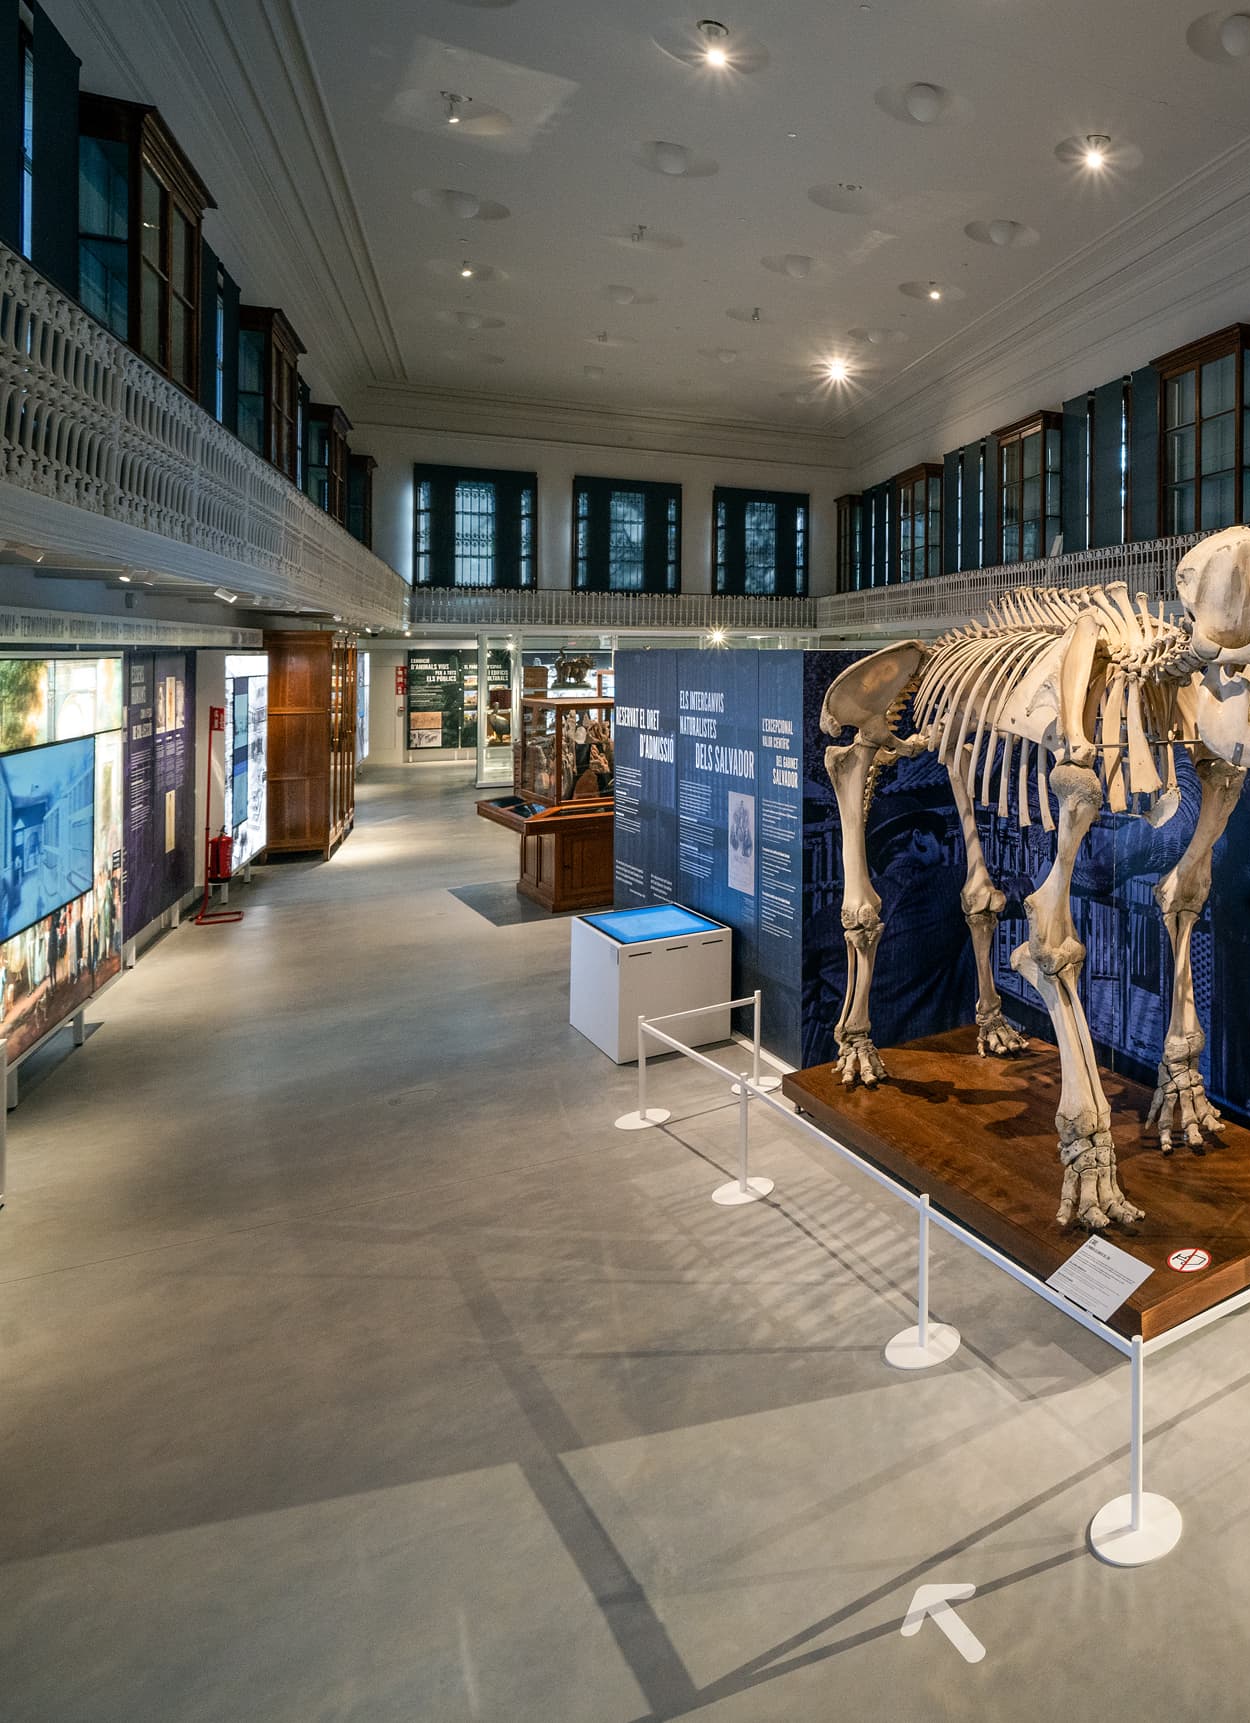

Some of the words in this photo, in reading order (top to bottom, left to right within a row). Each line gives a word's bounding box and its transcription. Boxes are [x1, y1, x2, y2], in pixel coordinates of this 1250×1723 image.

[680, 690, 689, 710] ELS
[690, 691, 724, 713] INTERCANVIS
[616, 706, 639, 728] RESERVAT
[640, 708, 646, 729] EL
[646, 709, 660, 731] DRET
[680, 716, 717, 740] NATURALISTES
[640, 733, 674, 764] D'ADMISSIÓ
[696, 742, 713, 772] DELS
[714, 744, 755, 780] SALVADOR
